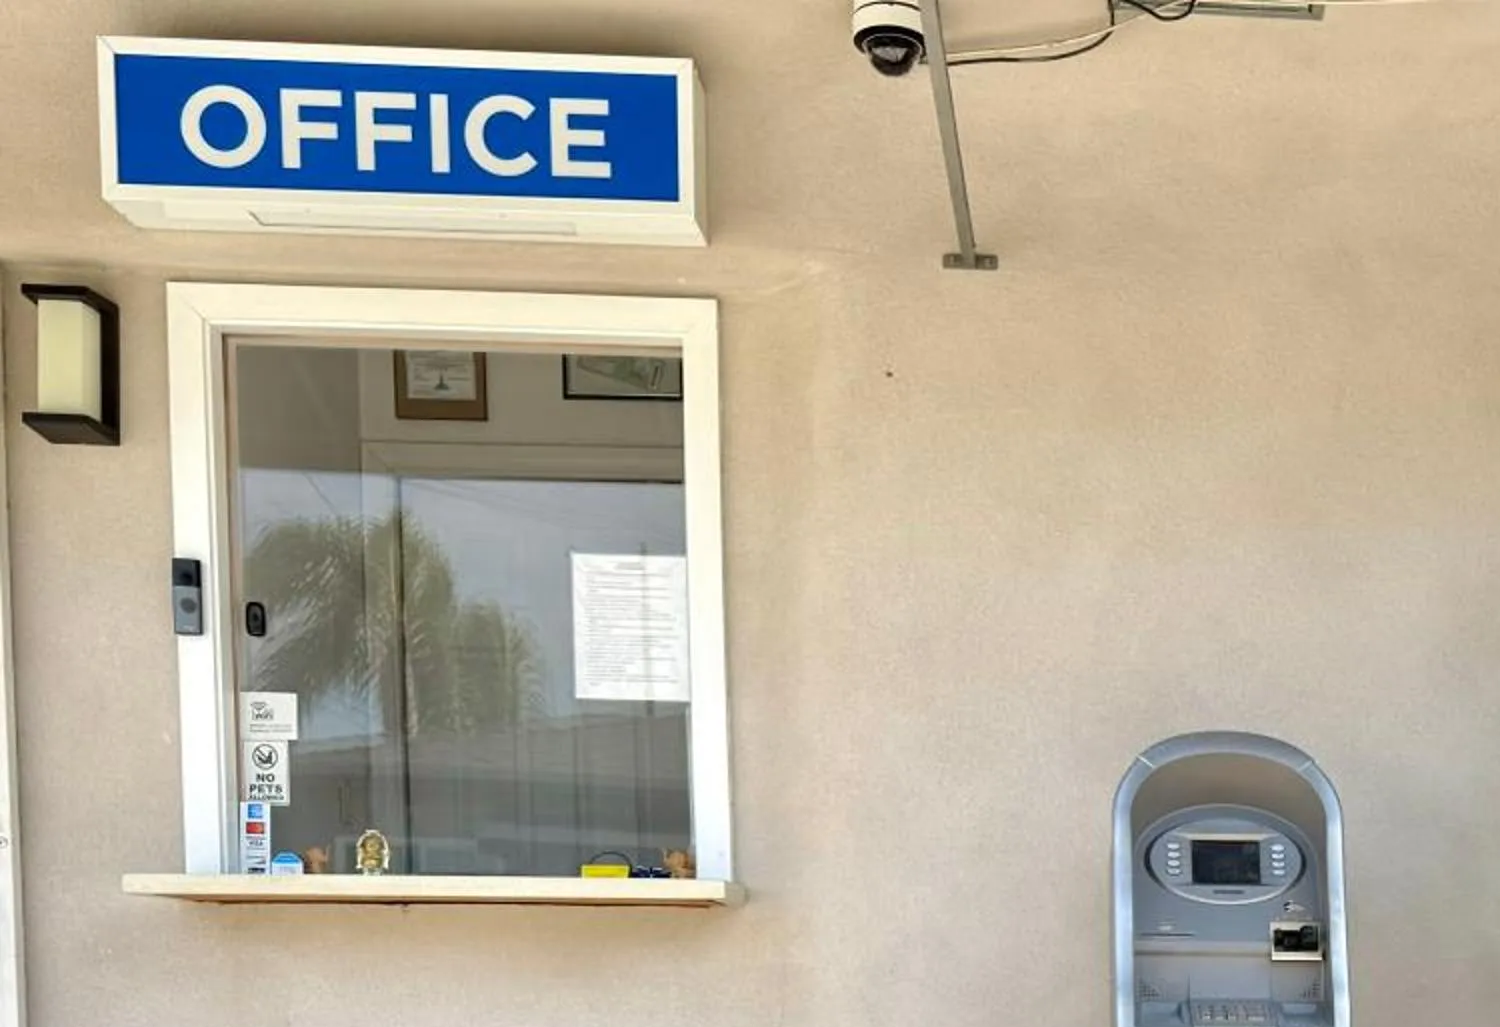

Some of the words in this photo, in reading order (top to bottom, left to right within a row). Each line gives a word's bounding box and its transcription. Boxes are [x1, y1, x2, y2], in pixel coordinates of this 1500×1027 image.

[180, 85, 611, 179] OFFICE
[255, 773, 276, 783] NO
[249, 783, 284, 793] PETS
